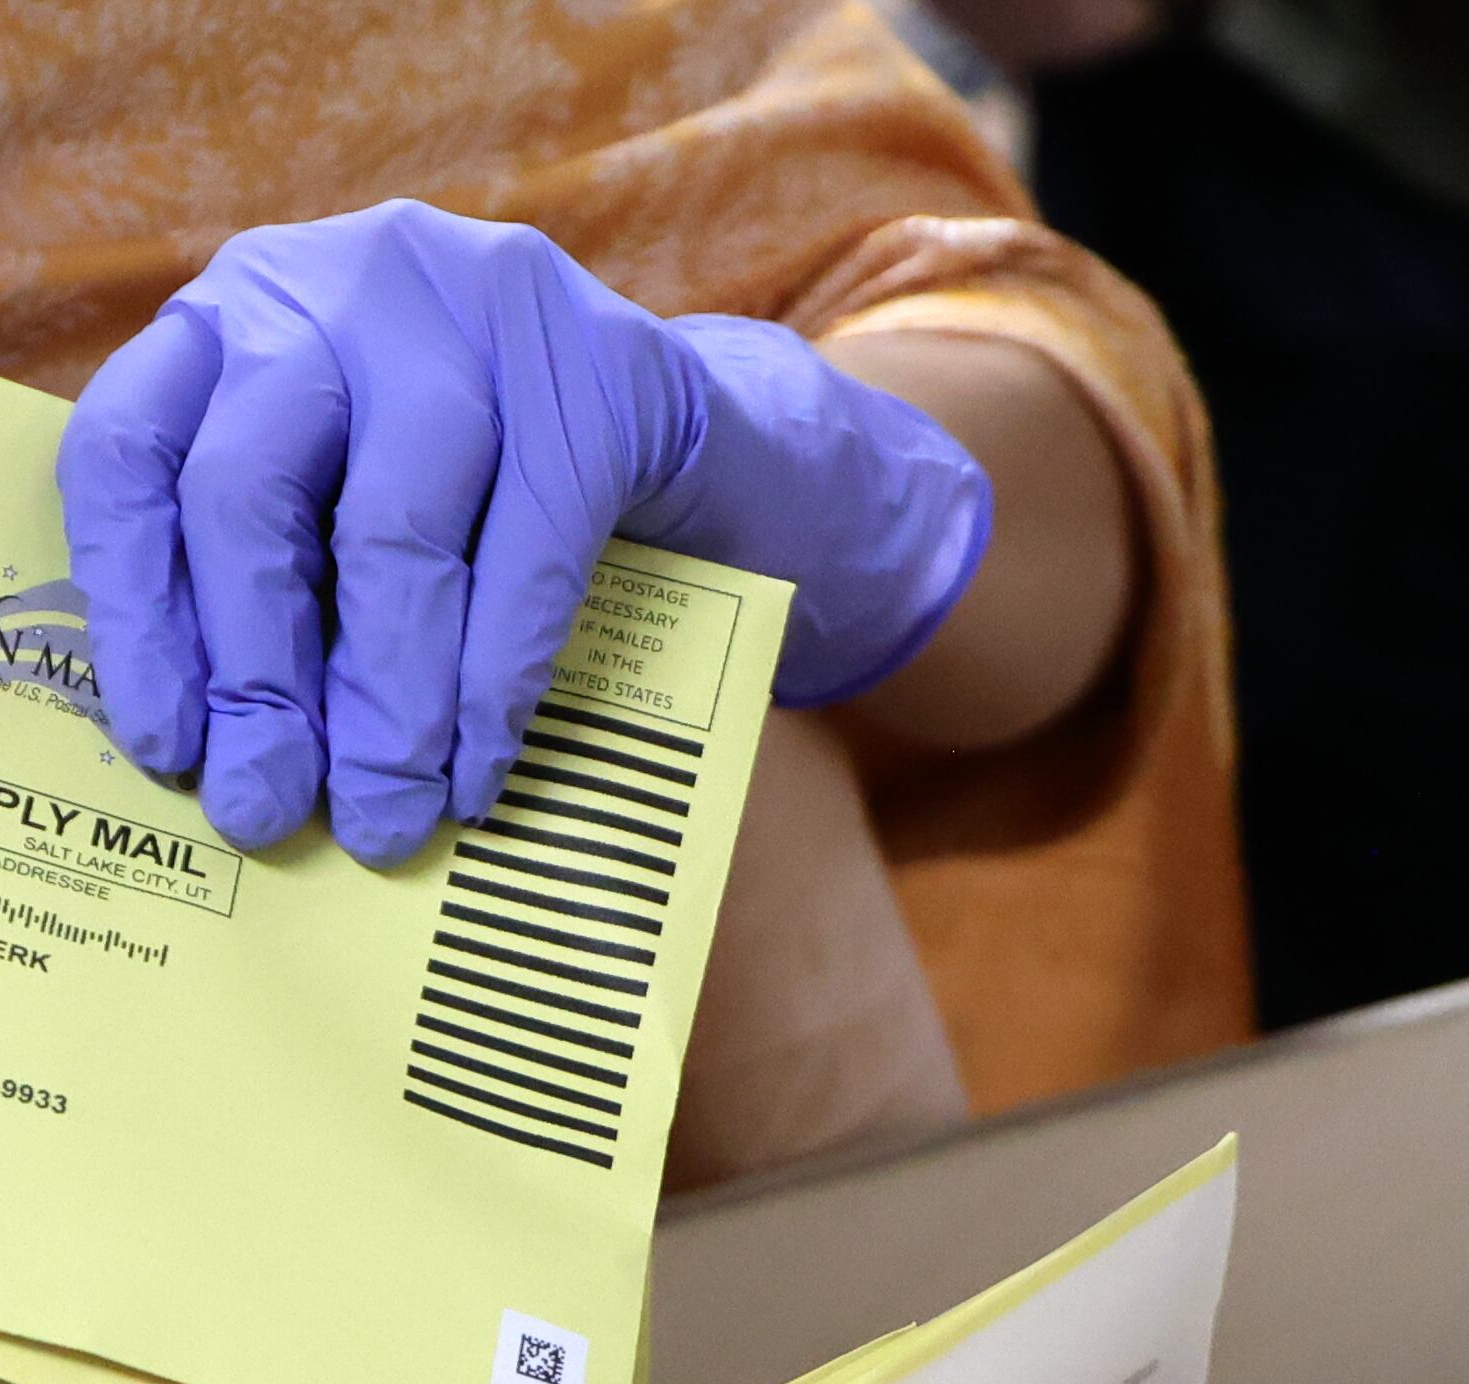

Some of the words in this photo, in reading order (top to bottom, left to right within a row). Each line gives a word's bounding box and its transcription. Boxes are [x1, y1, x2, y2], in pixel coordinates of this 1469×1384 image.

[591, 571, 605, 586] O
[610, 576, 689, 607] POSTAGE
[580, 619, 596, 633] IF
[599, 625, 663, 653] MAILED
[32, 641, 101, 698] MA
[588, 648, 607, 665] IN
[613, 653, 644, 675] THE
[14, 681, 41, 704] U.S.
[46, 692, 90, 718] Postal
[614, 682, 673, 710] STATES
[91, 817, 207, 878] MAIL
[24, 837, 73, 860] SALT
[73, 852, 126, 878] LAKE
[186, 883, 212, 901] UT
